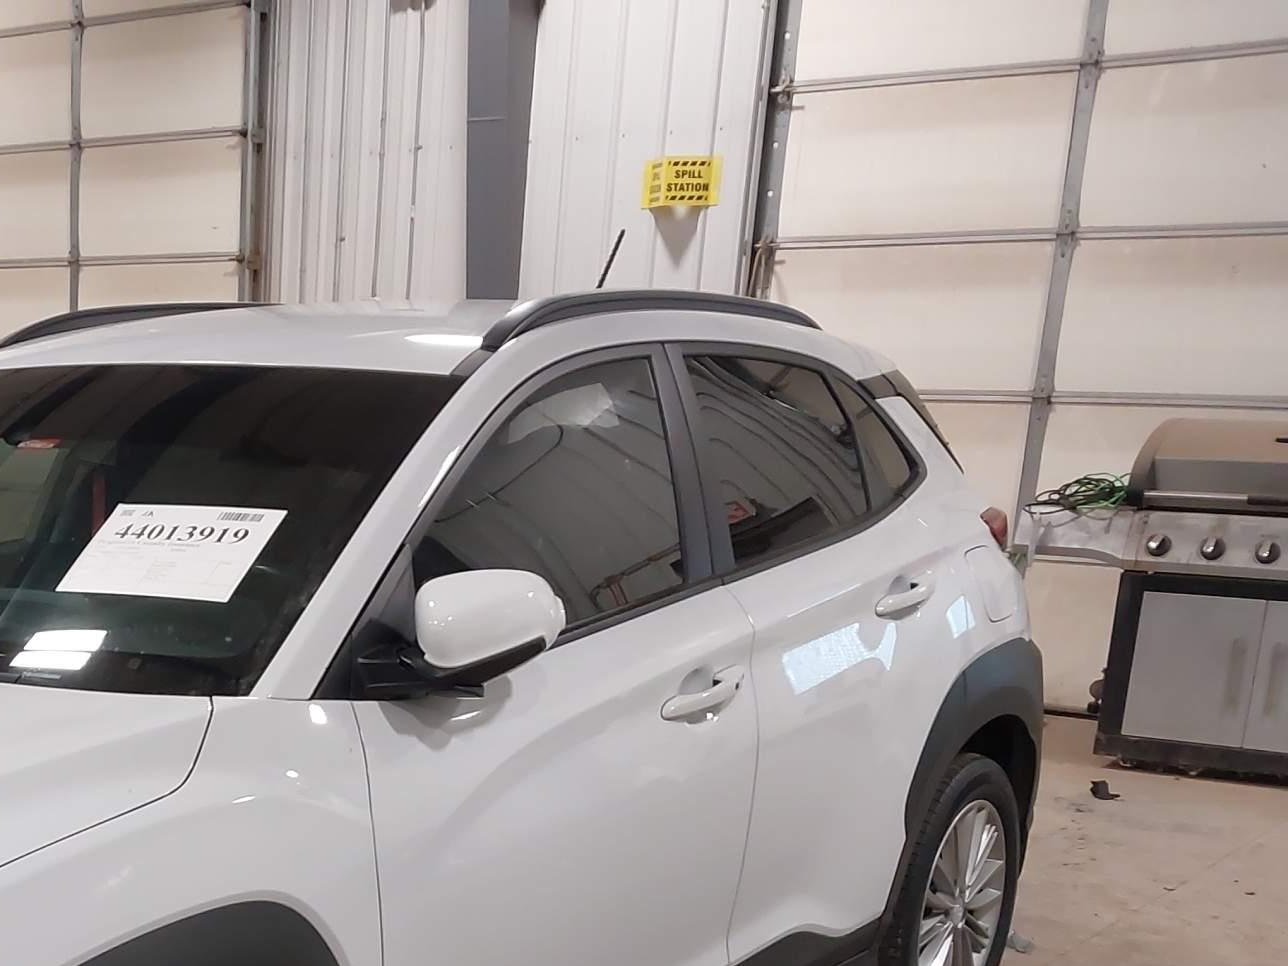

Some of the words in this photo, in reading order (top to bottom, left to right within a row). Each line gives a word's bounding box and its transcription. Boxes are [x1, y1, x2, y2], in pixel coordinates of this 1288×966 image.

[674, 169, 703, 179] SPILL
[666, 182, 710, 193] STATION
[114, 523, 251, 545] 44013919
